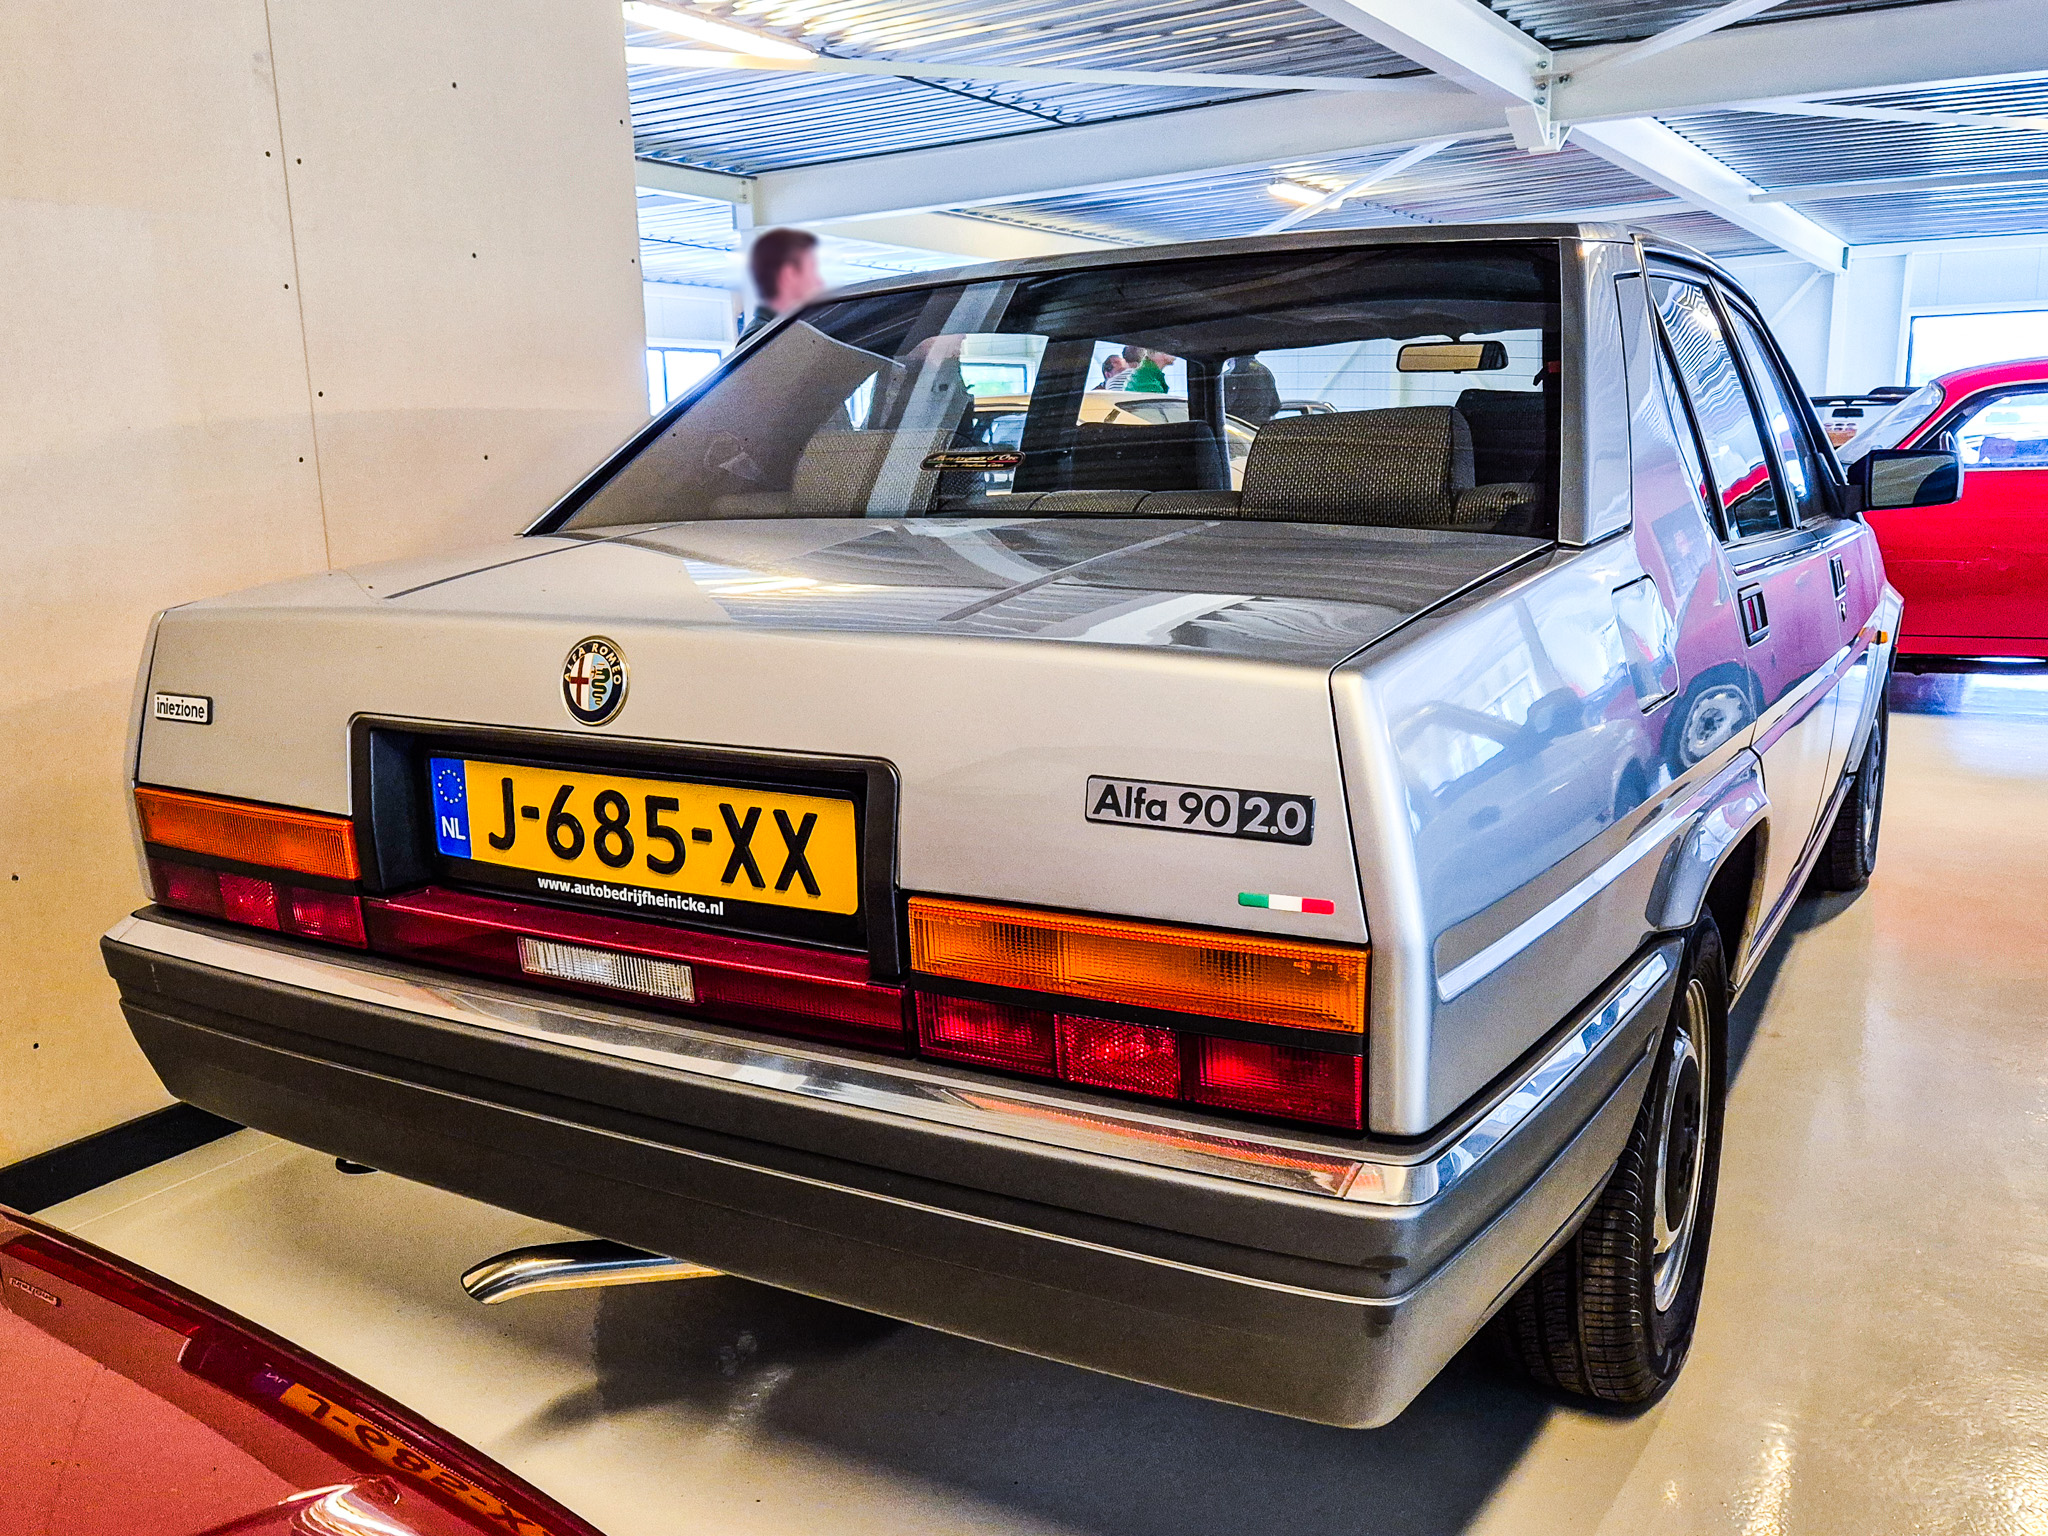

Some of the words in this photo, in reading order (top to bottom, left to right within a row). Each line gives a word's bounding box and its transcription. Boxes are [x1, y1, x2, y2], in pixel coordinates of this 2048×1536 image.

[564, 646, 586, 682] ALFA
[591, 642, 622, 685] ROMEO
[156, 696, 205, 719] iniezione
[441, 815, 467, 841] NL
[1092, 783, 1167, 822] Alfa
[1178, 791, 1232, 828] 90
[1242, 796, 1308, 836] 2.0
[488, 777, 822, 897] J-685-XX
[537, 877, 724, 916] www.autobedrijfheinicke.nl
